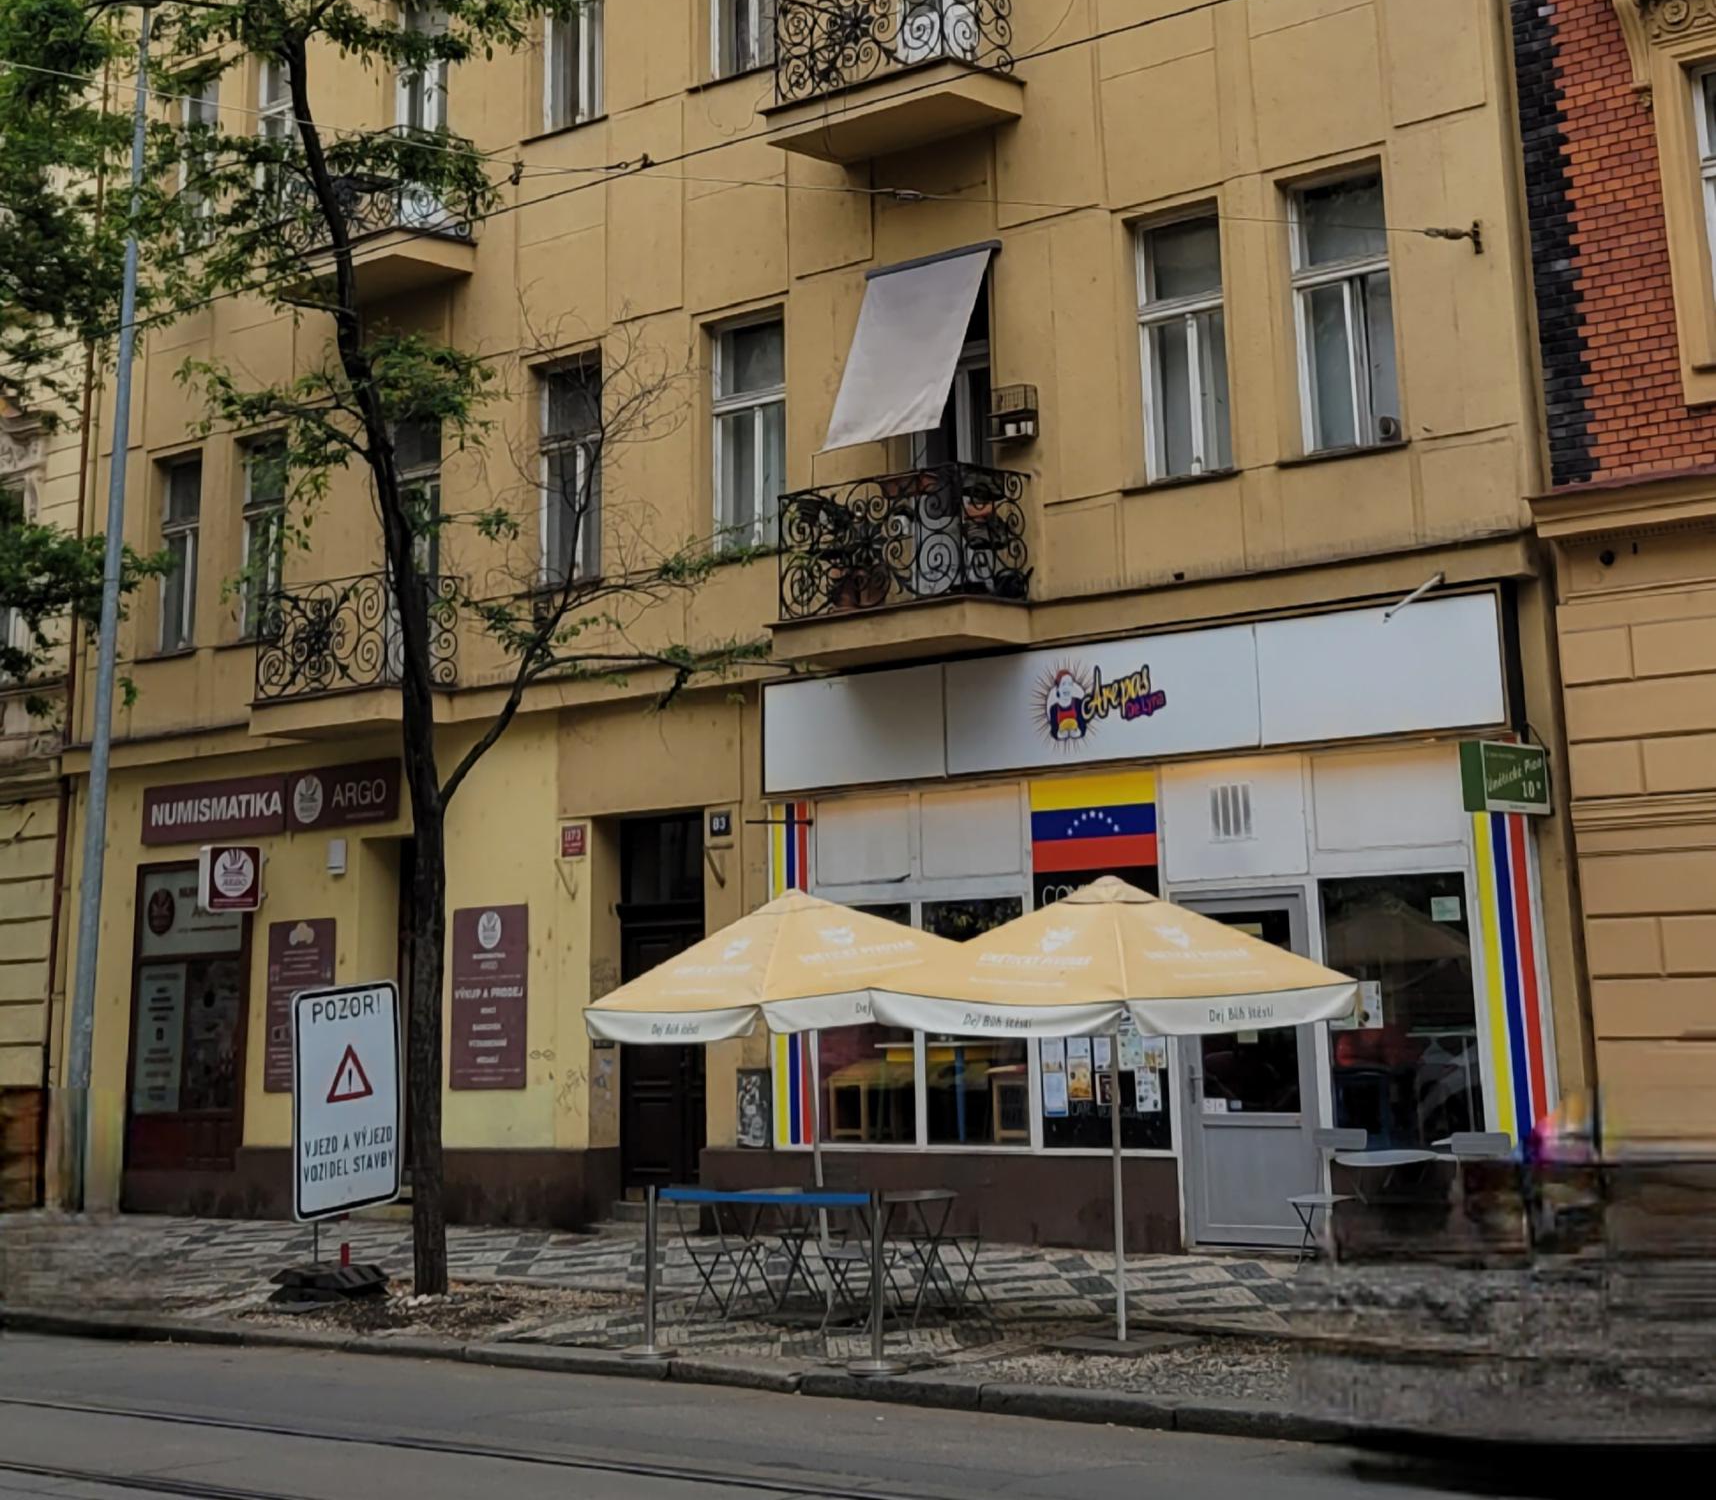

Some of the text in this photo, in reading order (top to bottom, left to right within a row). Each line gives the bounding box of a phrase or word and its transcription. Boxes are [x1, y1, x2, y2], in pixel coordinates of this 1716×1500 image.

[1081, 664, 1151, 721] Arepas
[151, 790, 283, 828] NUMISMATIKA
[331, 778, 387, 809] ARGO
[312, 993, 382, 1024] POZOR!
[962, 1012, 981, 1029] Dej
[1208, 1008, 1225, 1025] Dej
[304, 1124, 393, 1159] VJEZD A VÝJEZD
[303, 1148, 395, 1184] VOZIDEL STAVBY
